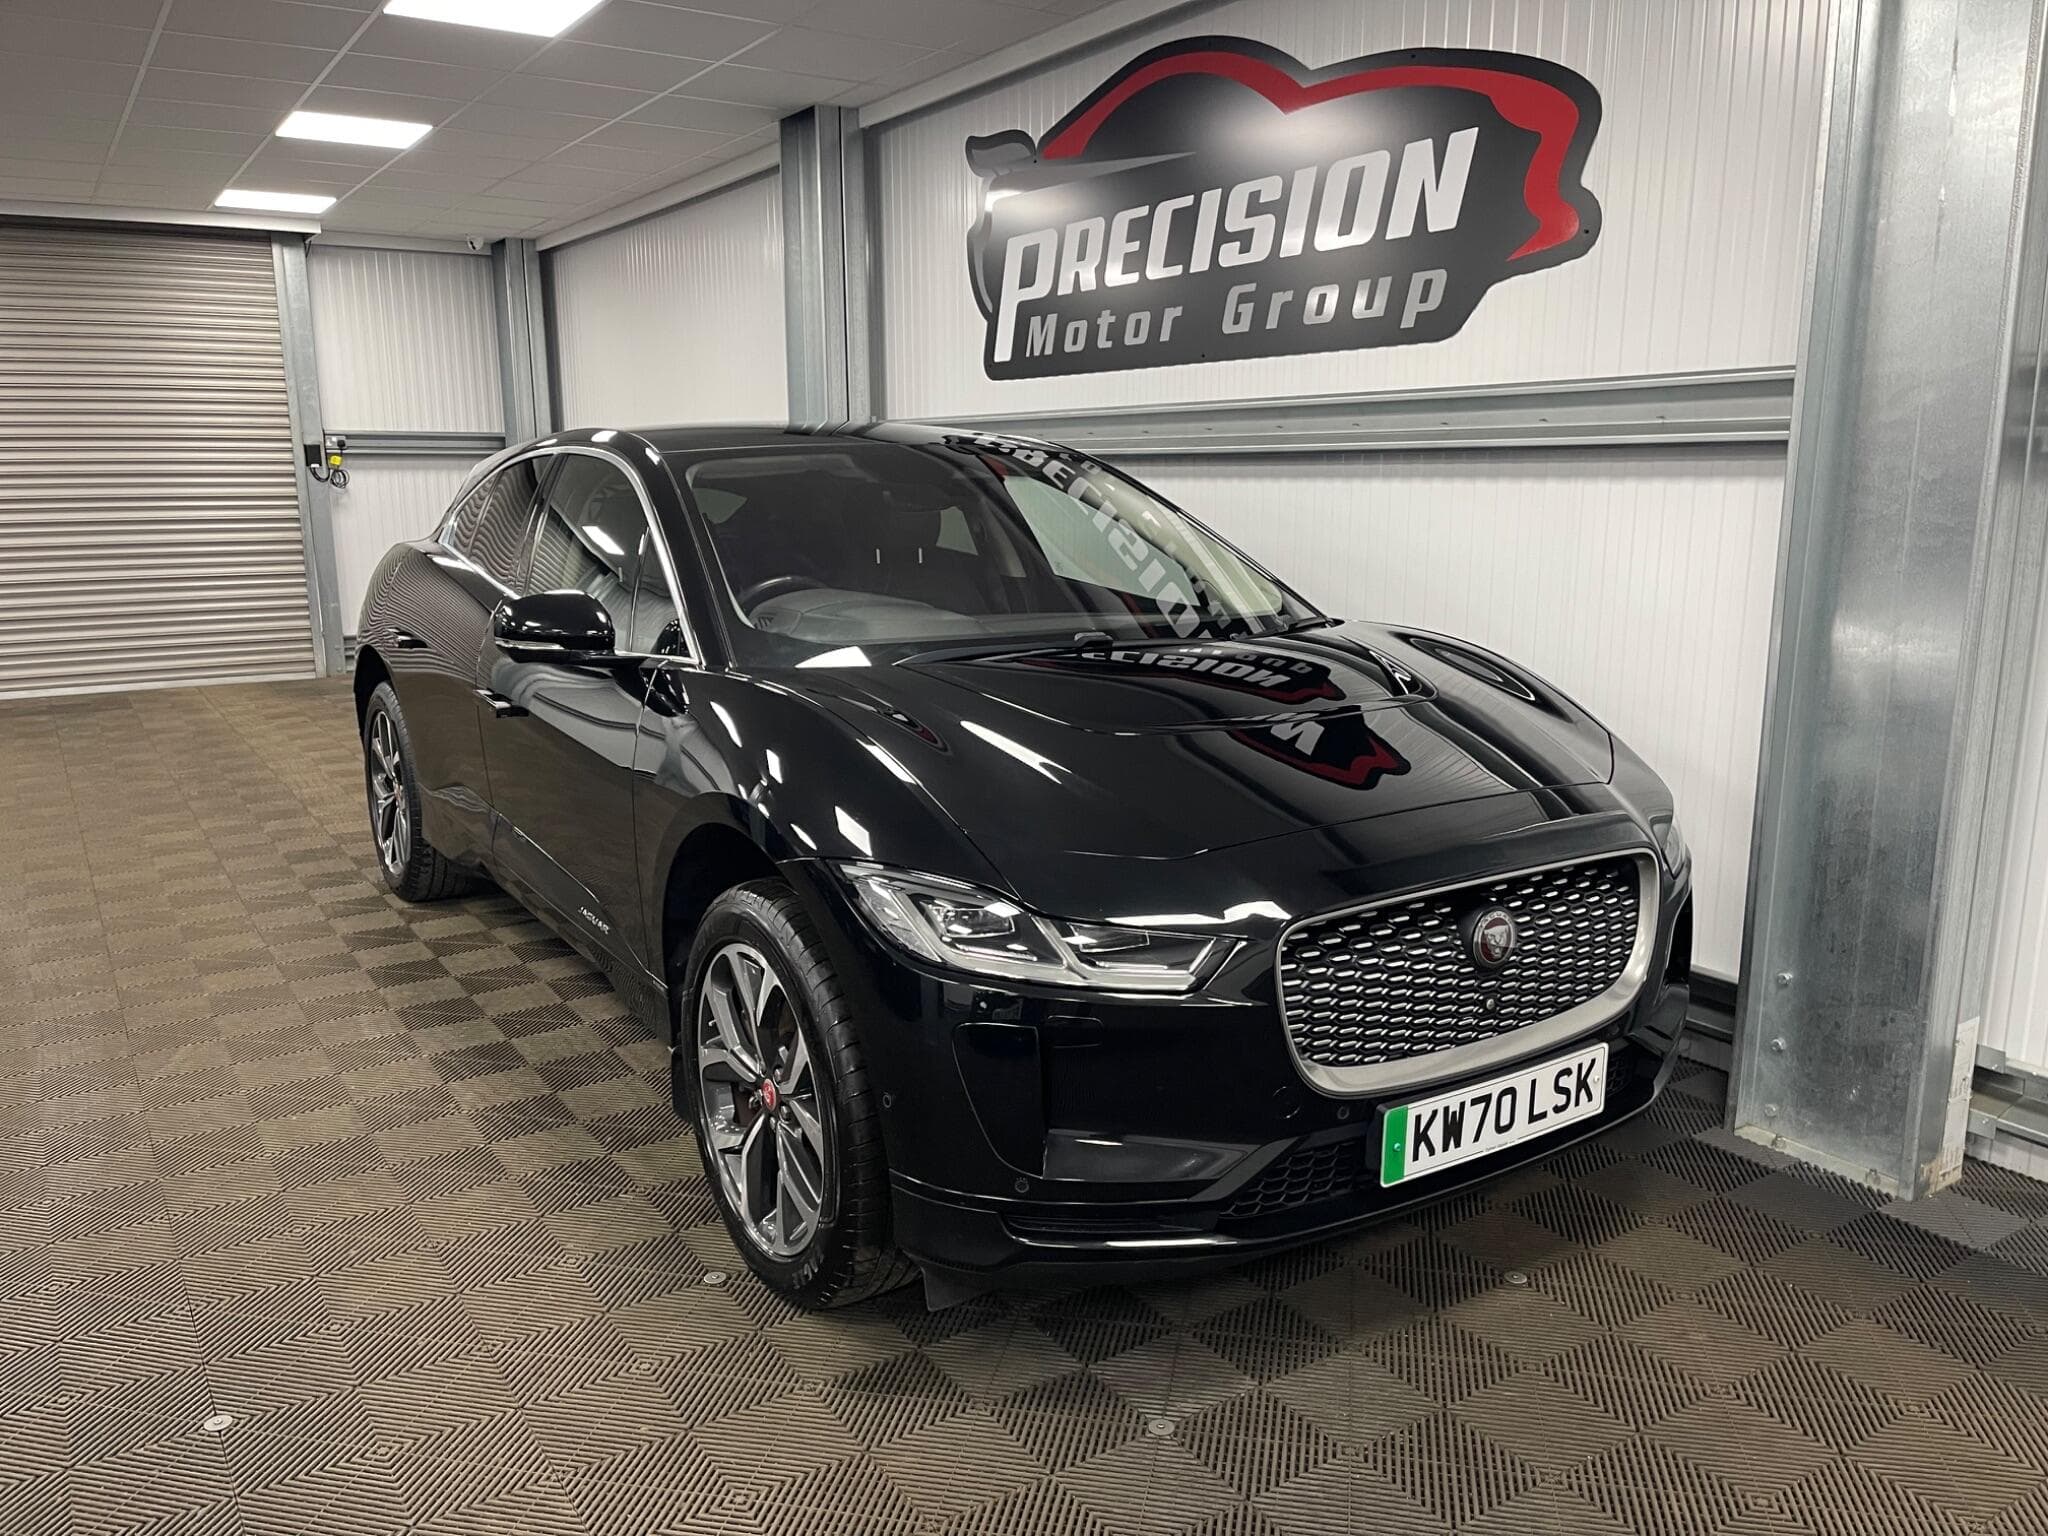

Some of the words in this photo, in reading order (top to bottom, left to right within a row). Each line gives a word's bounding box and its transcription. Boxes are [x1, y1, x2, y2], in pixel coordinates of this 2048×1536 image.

[993, 126, 1480, 363] PRECISION
[1025, 305, 1183, 358] Motor
[1221, 268, 1449, 335] Group
[1412, 1086, 1517, 1163] KW70
[1527, 1057, 1597, 1125] LSK
